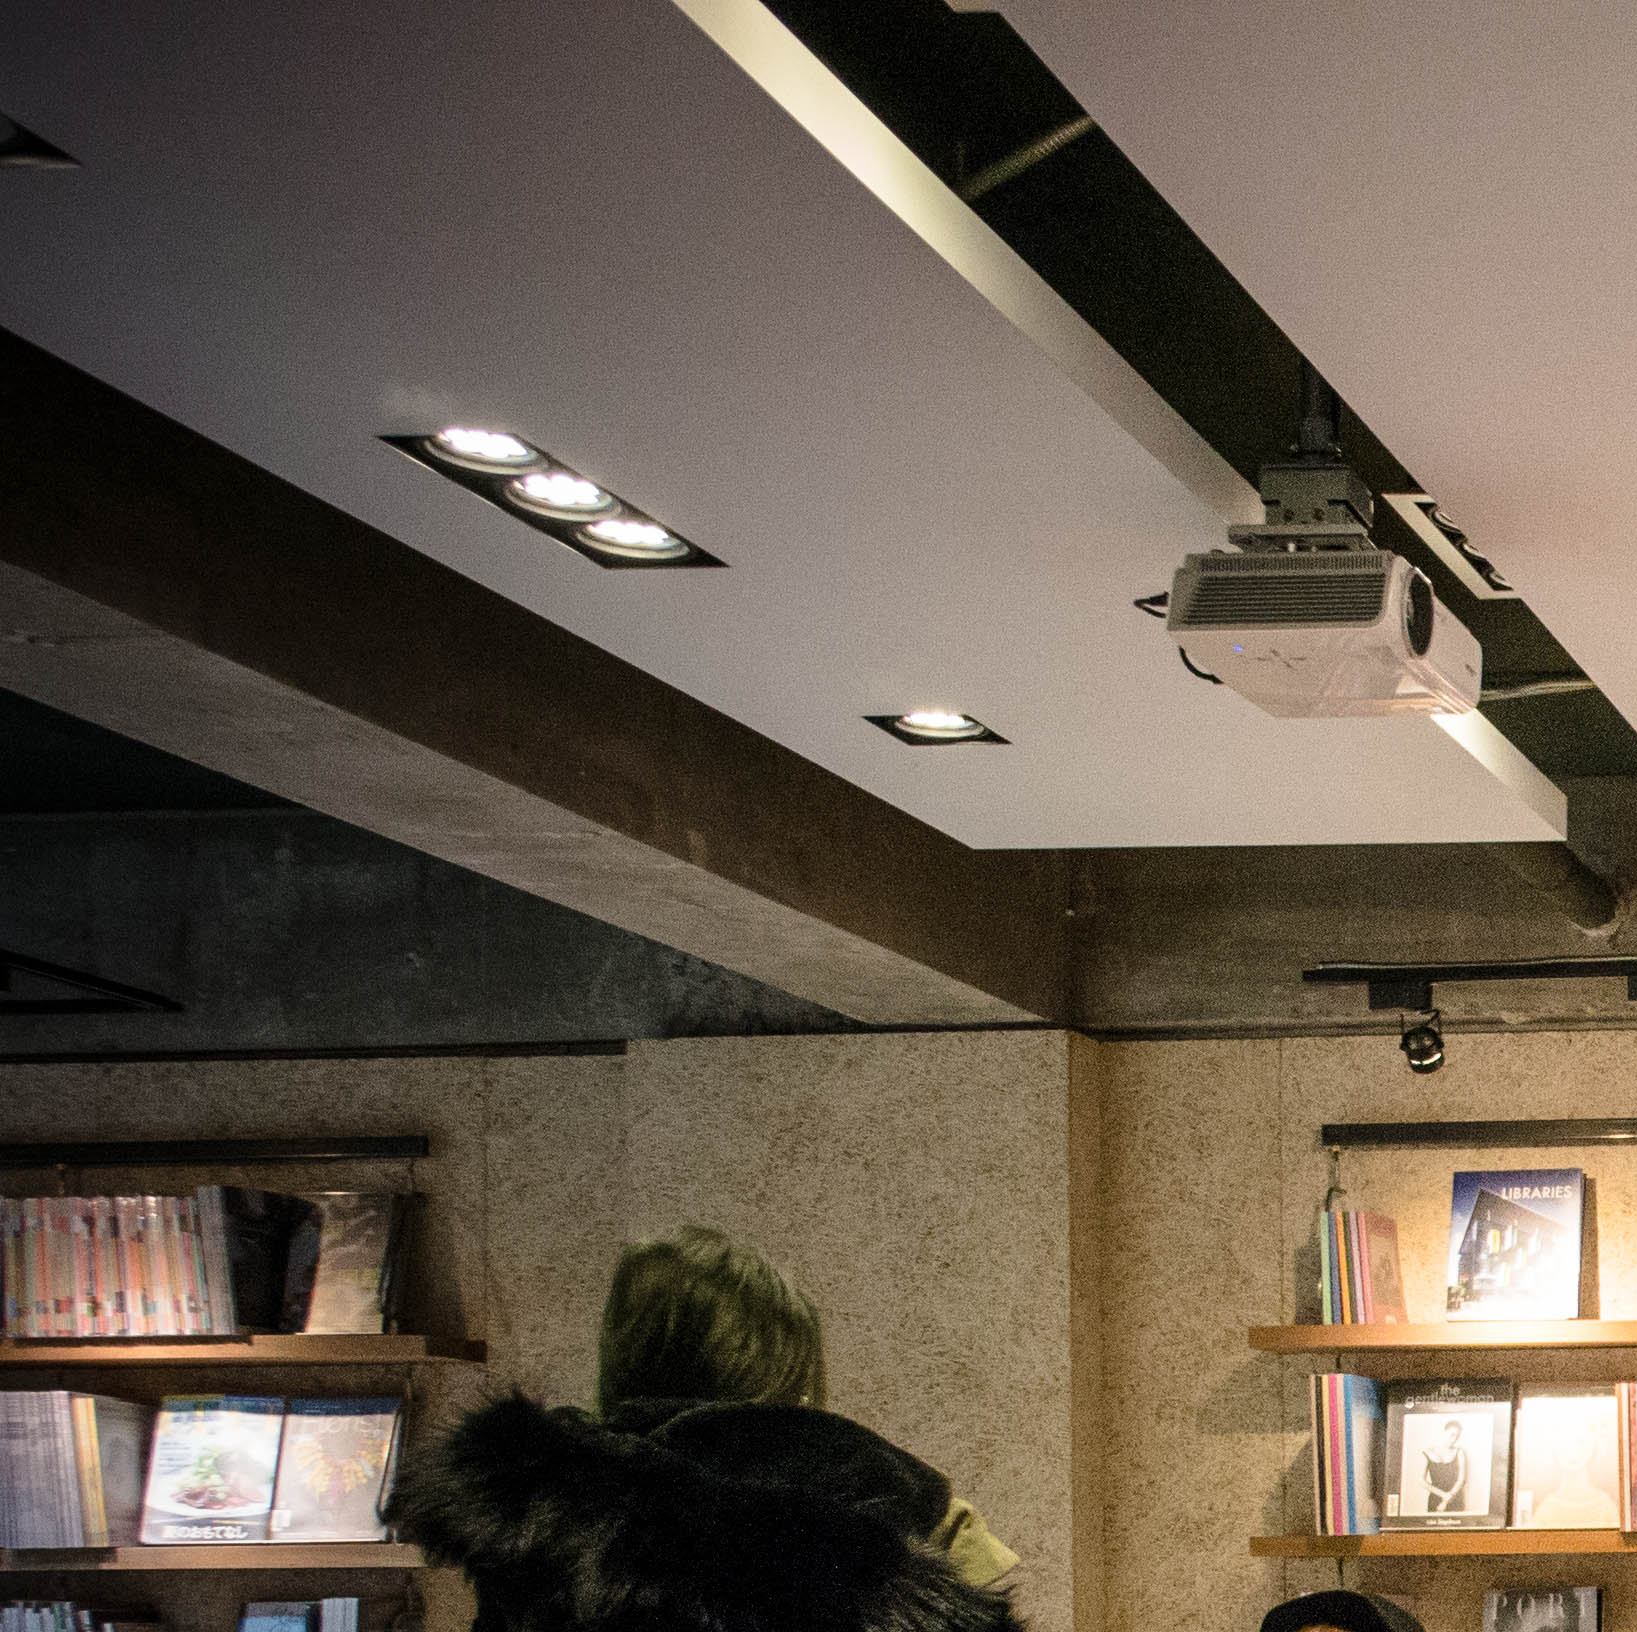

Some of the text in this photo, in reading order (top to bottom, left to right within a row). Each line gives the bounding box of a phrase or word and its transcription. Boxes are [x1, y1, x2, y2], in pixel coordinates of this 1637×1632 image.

[1501, 1186, 1573, 1200] LIBRARIES
[1441, 1383, 1461, 1396] the
[1491, 1592, 1589, 1620] PORT
